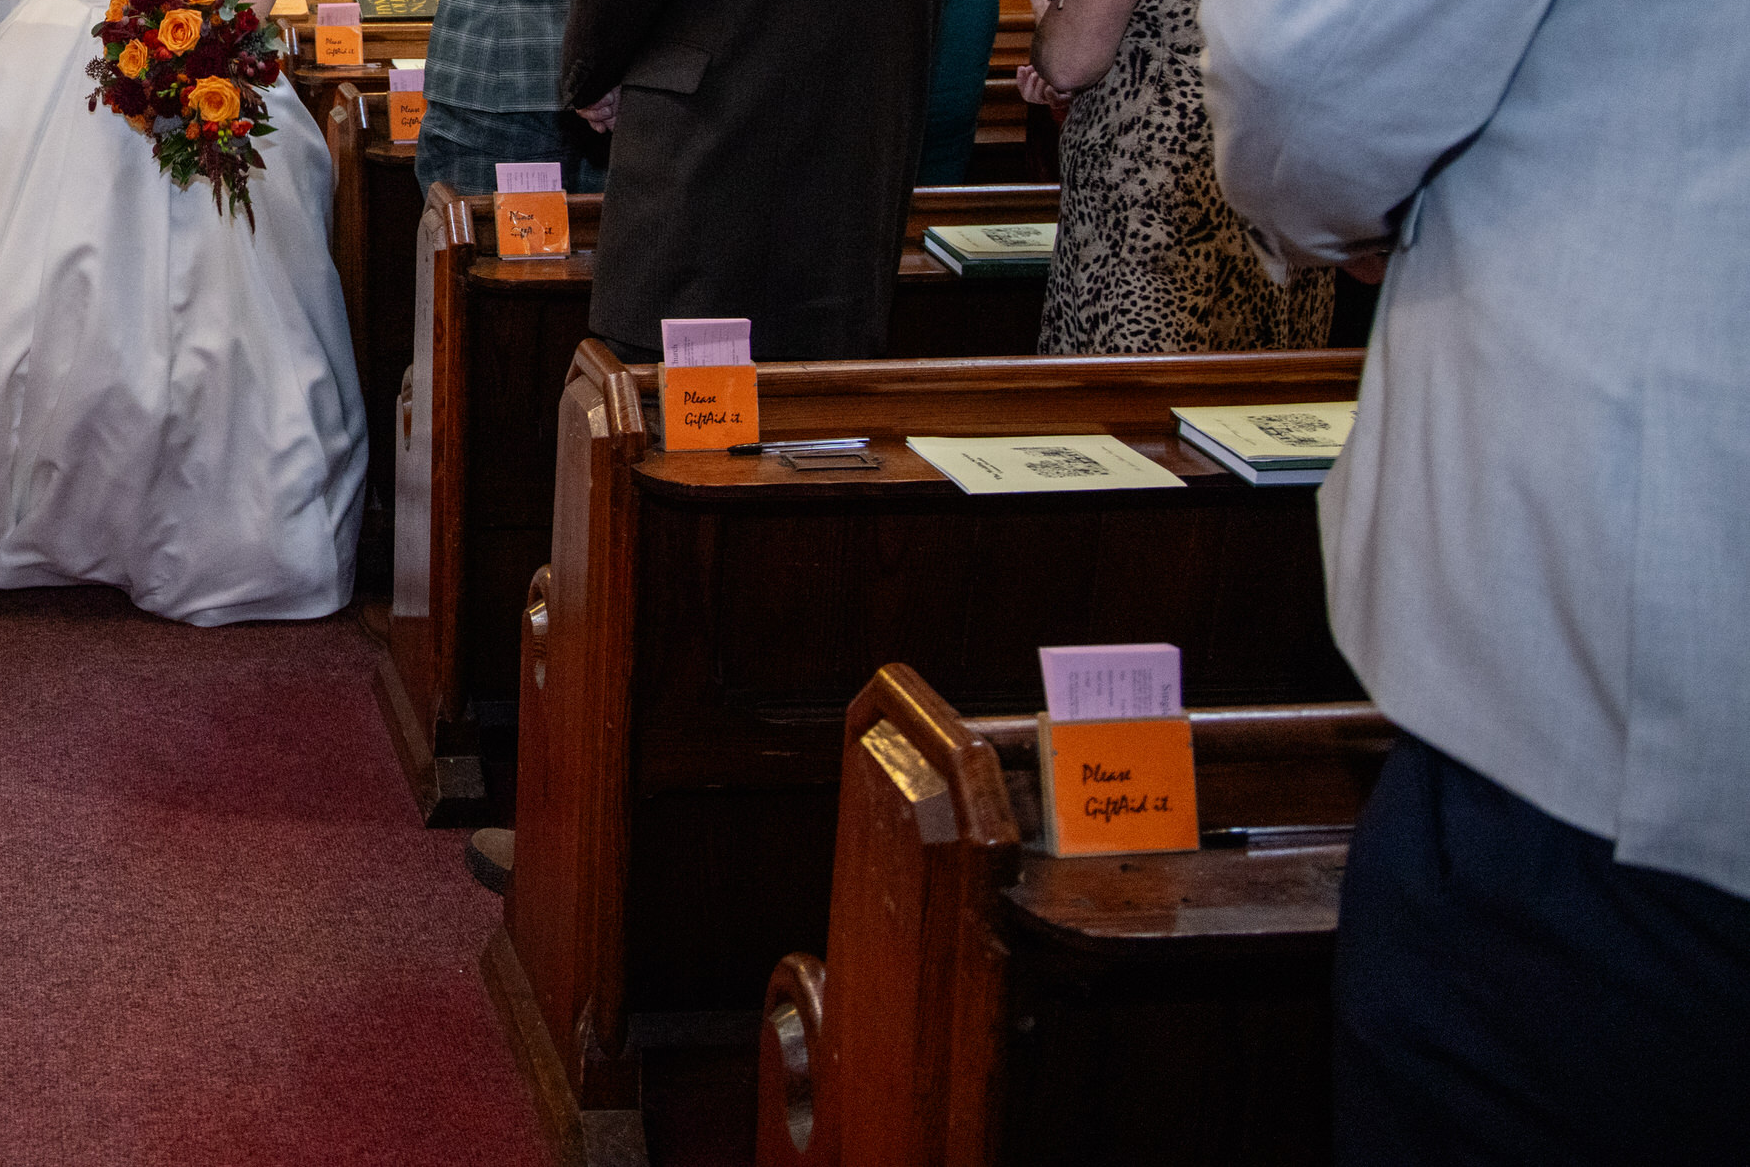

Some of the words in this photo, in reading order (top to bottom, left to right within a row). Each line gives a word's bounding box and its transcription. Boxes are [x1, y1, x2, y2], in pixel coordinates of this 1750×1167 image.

[400, 104, 420, 114] Please
[401, 117, 422, 128] GiftA
[684, 391, 716, 405] Please
[684, 411, 726, 430] GiftAid
[730, 413, 743, 423] it.
[1081, 763, 1132, 786] Please
[1084, 795, 1148, 824] GiftAid
